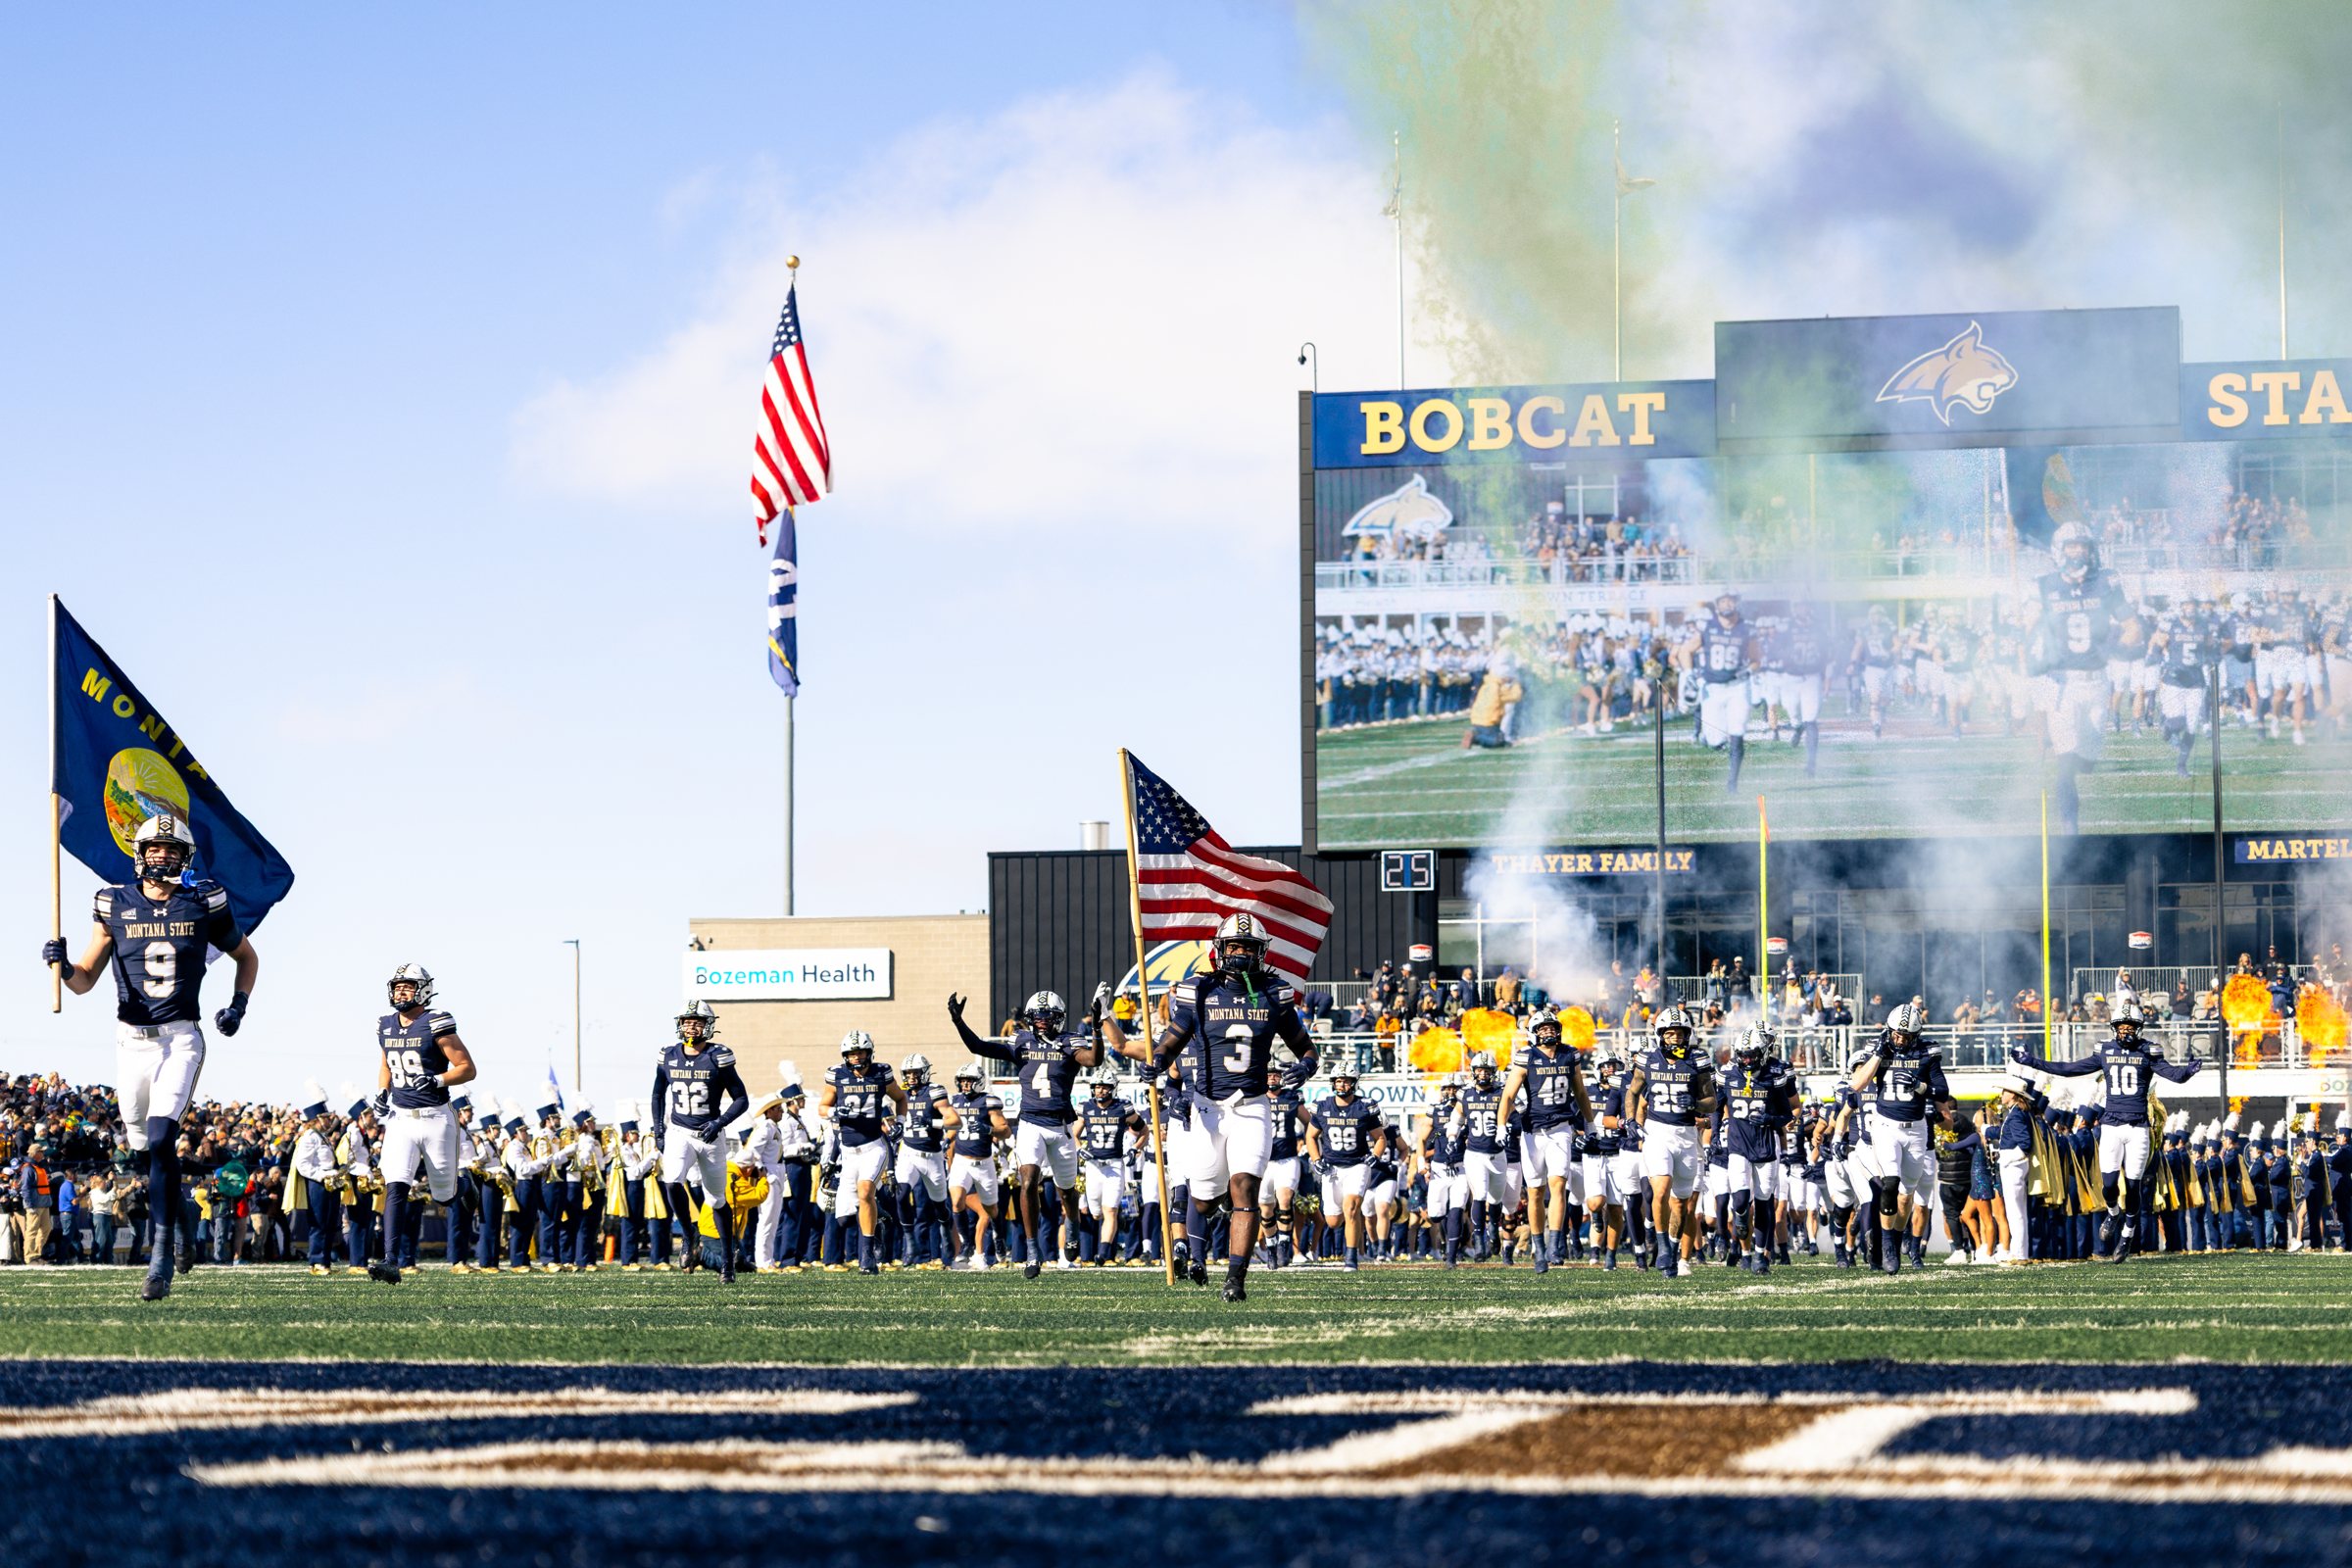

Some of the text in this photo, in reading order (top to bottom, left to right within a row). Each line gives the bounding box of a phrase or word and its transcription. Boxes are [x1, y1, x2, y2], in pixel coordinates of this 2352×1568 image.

[2207, 369, 2352, 427] STA
[1359, 392, 1666, 455] BOBCAT
[81, 667, 220, 791] MONTA
[1492, 851, 1694, 874] THAYER FAMILY
[2247, 838, 2352, 860] MARTEL
[1387, 855, 1429, 886] 25
[124, 922, 195, 939] MONTANA STATE
[143, 942, 176, 999] 9
[696, 963, 875, 985] Bozeman Health
[1208, 1008, 1269, 1021] MONTANA STATE
[406, 1038, 421, 1048] STATE
[1223, 1024, 1253, 1073] 3
[387, 1051, 424, 1088] 89
[694, 1069, 710, 1079] STATE
[1032, 1063, 1051, 1098] 4
[1675, 1073, 1690, 1082] STATE
[2110, 1065, 2138, 1096] 10
[671, 1081, 710, 1115] 32
[1538, 1076, 1568, 1104] 48
[1651, 1083, 1689, 1113] 25
[1091, 1125, 1118, 1149] 37
